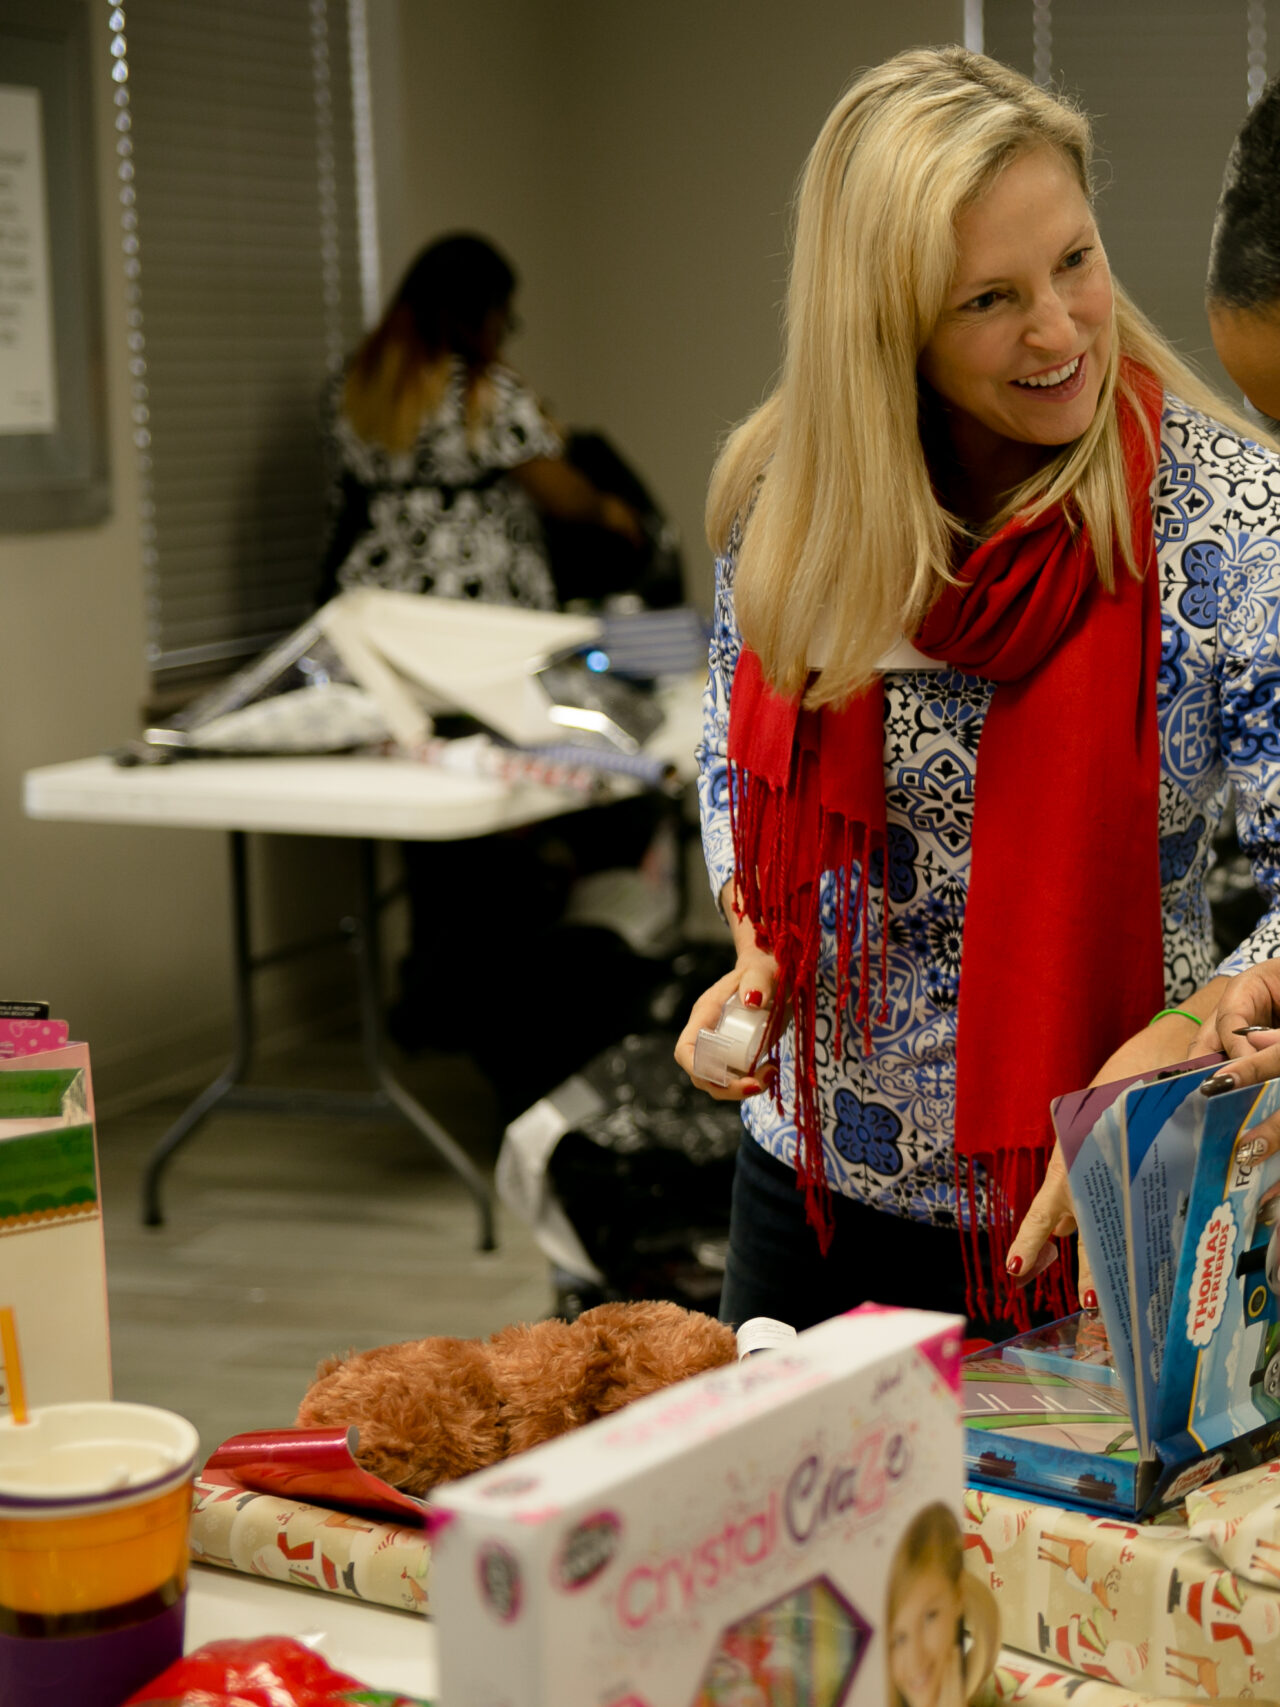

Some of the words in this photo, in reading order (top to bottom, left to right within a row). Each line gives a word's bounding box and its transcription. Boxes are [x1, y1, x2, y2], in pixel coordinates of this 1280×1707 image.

[1193, 1219, 1221, 1335] THOMAS
[1210, 1224, 1230, 1304] FRIENDS
[1207, 1304, 1216, 1319] &
